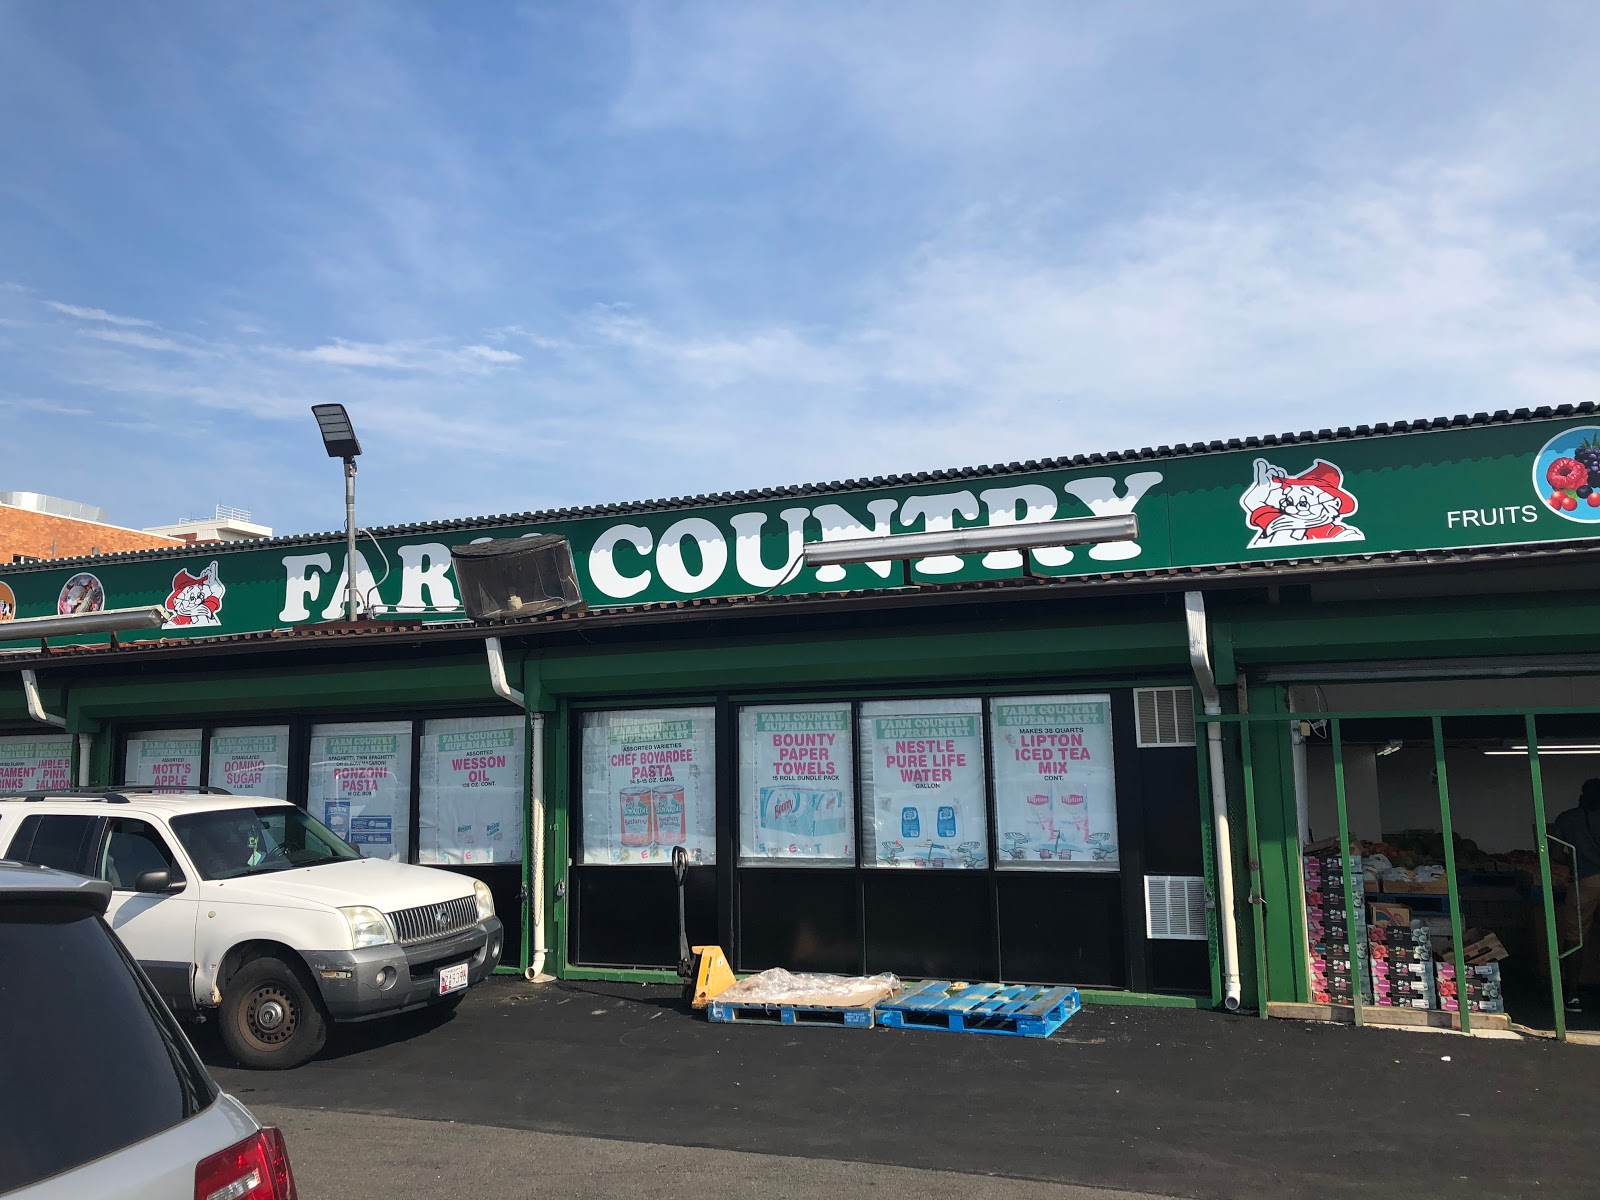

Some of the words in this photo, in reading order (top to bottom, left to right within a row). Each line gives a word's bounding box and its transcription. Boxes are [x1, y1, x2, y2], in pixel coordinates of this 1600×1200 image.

[1447, 505, 1538, 528] FRUITS
[279, 532, 542, 622] FAR
[588, 471, 1164, 599] COUNTRY
[1002, 706, 1036, 716] FARM
[1038, 704, 1099, 714] COUNTRY
[761, 713, 791, 722] FARM
[793, 711, 843, 721] COUNTRY
[1006, 713, 1099, 726] SUPERMARKET
[613, 725, 640, 736] FARM
[641, 721, 688, 733] COUNTRY
[764, 721, 843, 731] SUPERMARKET
[881, 719, 911, 729] FARM
[915, 717, 969, 728] COUNTRY
[442, 734, 466, 743] FARM
[468, 730, 511, 740] COUNTRY
[615, 730, 688, 744] SUPERMARKET
[884, 727, 970, 738] SUPERMARKET
[145, 741, 164, 749] FARM
[166, 740, 200, 749] COUNTRY
[216, 738, 236, 746] FARM
[238, 736, 273, 745] COUNTRY
[330, 737, 353, 746] FARM
[353, 736, 394, 745] COUNTRY
[444, 739, 511, 751] SUPERMARKET
[772, 733, 836, 746] BOUNTY
[1020, 734, 1083, 747] LIPTON
[146, 749, 200, 757] SUPERMARKET
[218, 744, 274, 753] SUPERMARKET
[332, 745, 394, 754] SUPERMARKET
[896, 740, 955, 754] NESTLE
[611, 753, 637, 767] CHEF
[640, 749, 692, 765] BOYARDEE
[779, 748, 829, 760] PAPER
[1015, 748, 1053, 761] ICED
[1057, 747, 1091, 760] TEA
[224, 760, 265, 772] DOMINO
[452, 755, 506, 771] WESSON
[886, 754, 928, 768] PURE
[932, 754, 966, 767] LIFE
[152, 763, 191, 775] MOTT'S
[334, 767, 388, 779] RONZONI
[632, 764, 673, 779] PASTA
[773, 762, 835, 775] TOWELS
[1038, 761, 1068, 774] MIX
[43, 769, 65, 779] PINK
[226, 773, 261, 784] SUGAR
[468, 770, 489, 783] OIL
[900, 768, 952, 782] WATER
[154, 775, 187, 786] APPLE
[342, 780, 378, 792] PASTA
